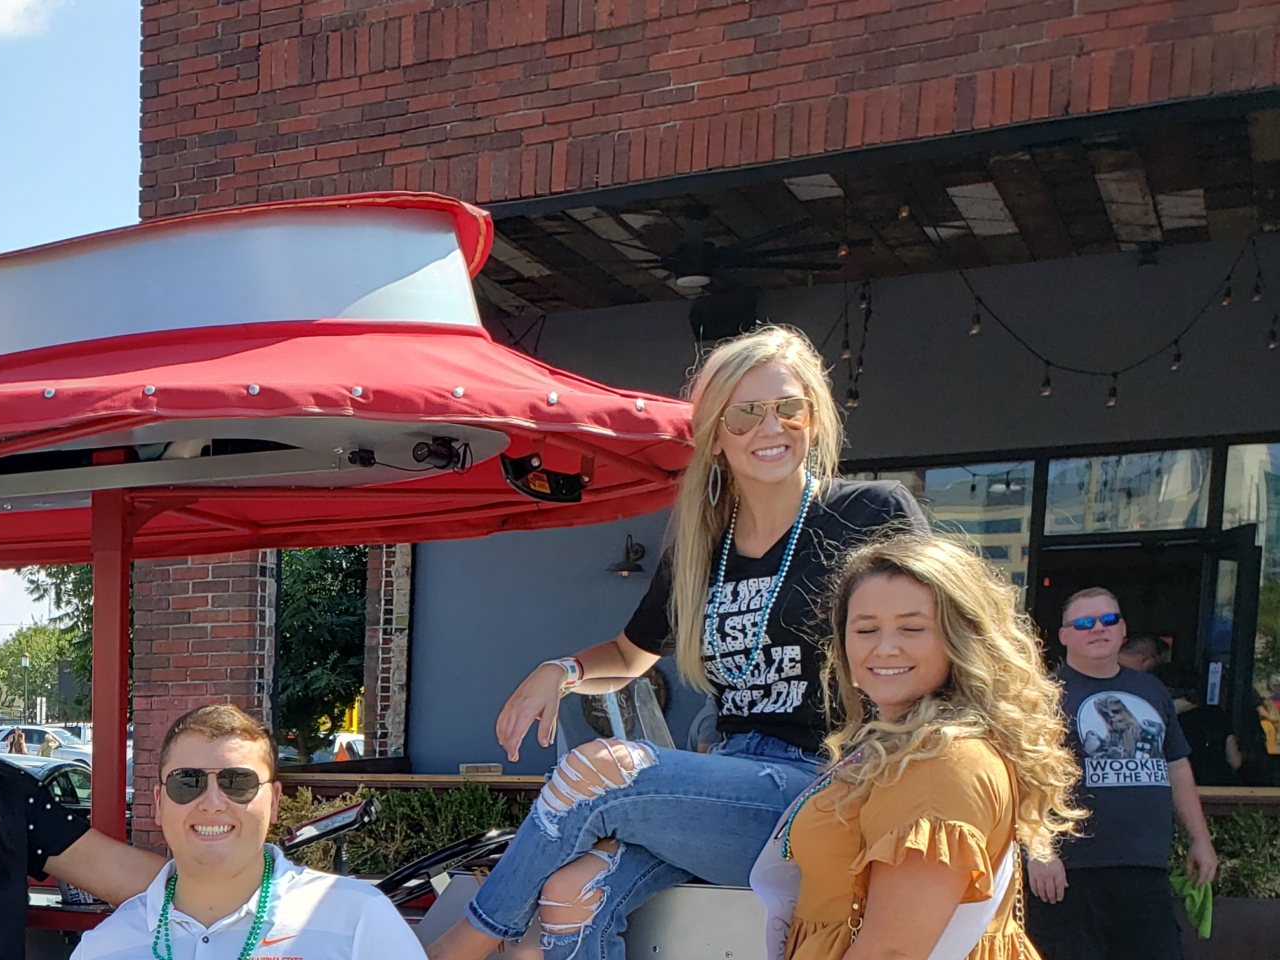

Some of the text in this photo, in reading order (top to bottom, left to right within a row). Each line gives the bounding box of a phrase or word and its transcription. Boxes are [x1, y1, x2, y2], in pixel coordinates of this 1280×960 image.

[703, 611, 771, 656] ASH
[1090, 772, 1109, 783] OF
[1114, 771, 1142, 783] THE
